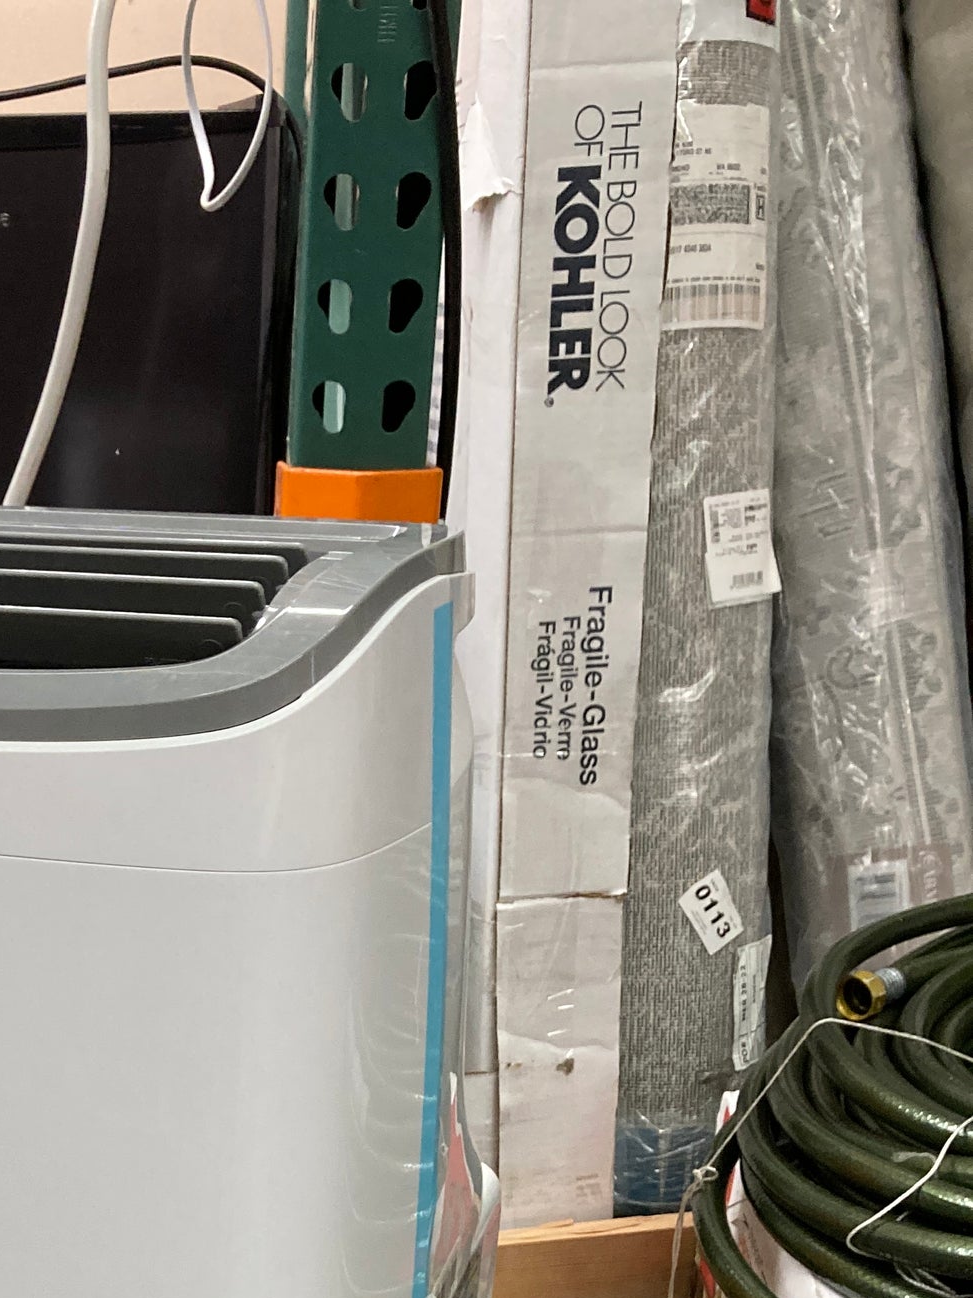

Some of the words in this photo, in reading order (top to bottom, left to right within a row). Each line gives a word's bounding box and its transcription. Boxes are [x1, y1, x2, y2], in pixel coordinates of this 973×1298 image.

[574, 104, 605, 157] OF
[608, 101, 642, 171] THE
[603, 180, 637, 279] BOLD
[548, 165, 602, 396] KOHLER
[595, 290, 631, 392] LOOK
[579, 586, 613, 786] Fragile-Glass
[695, 885, 731, 938] 0113
